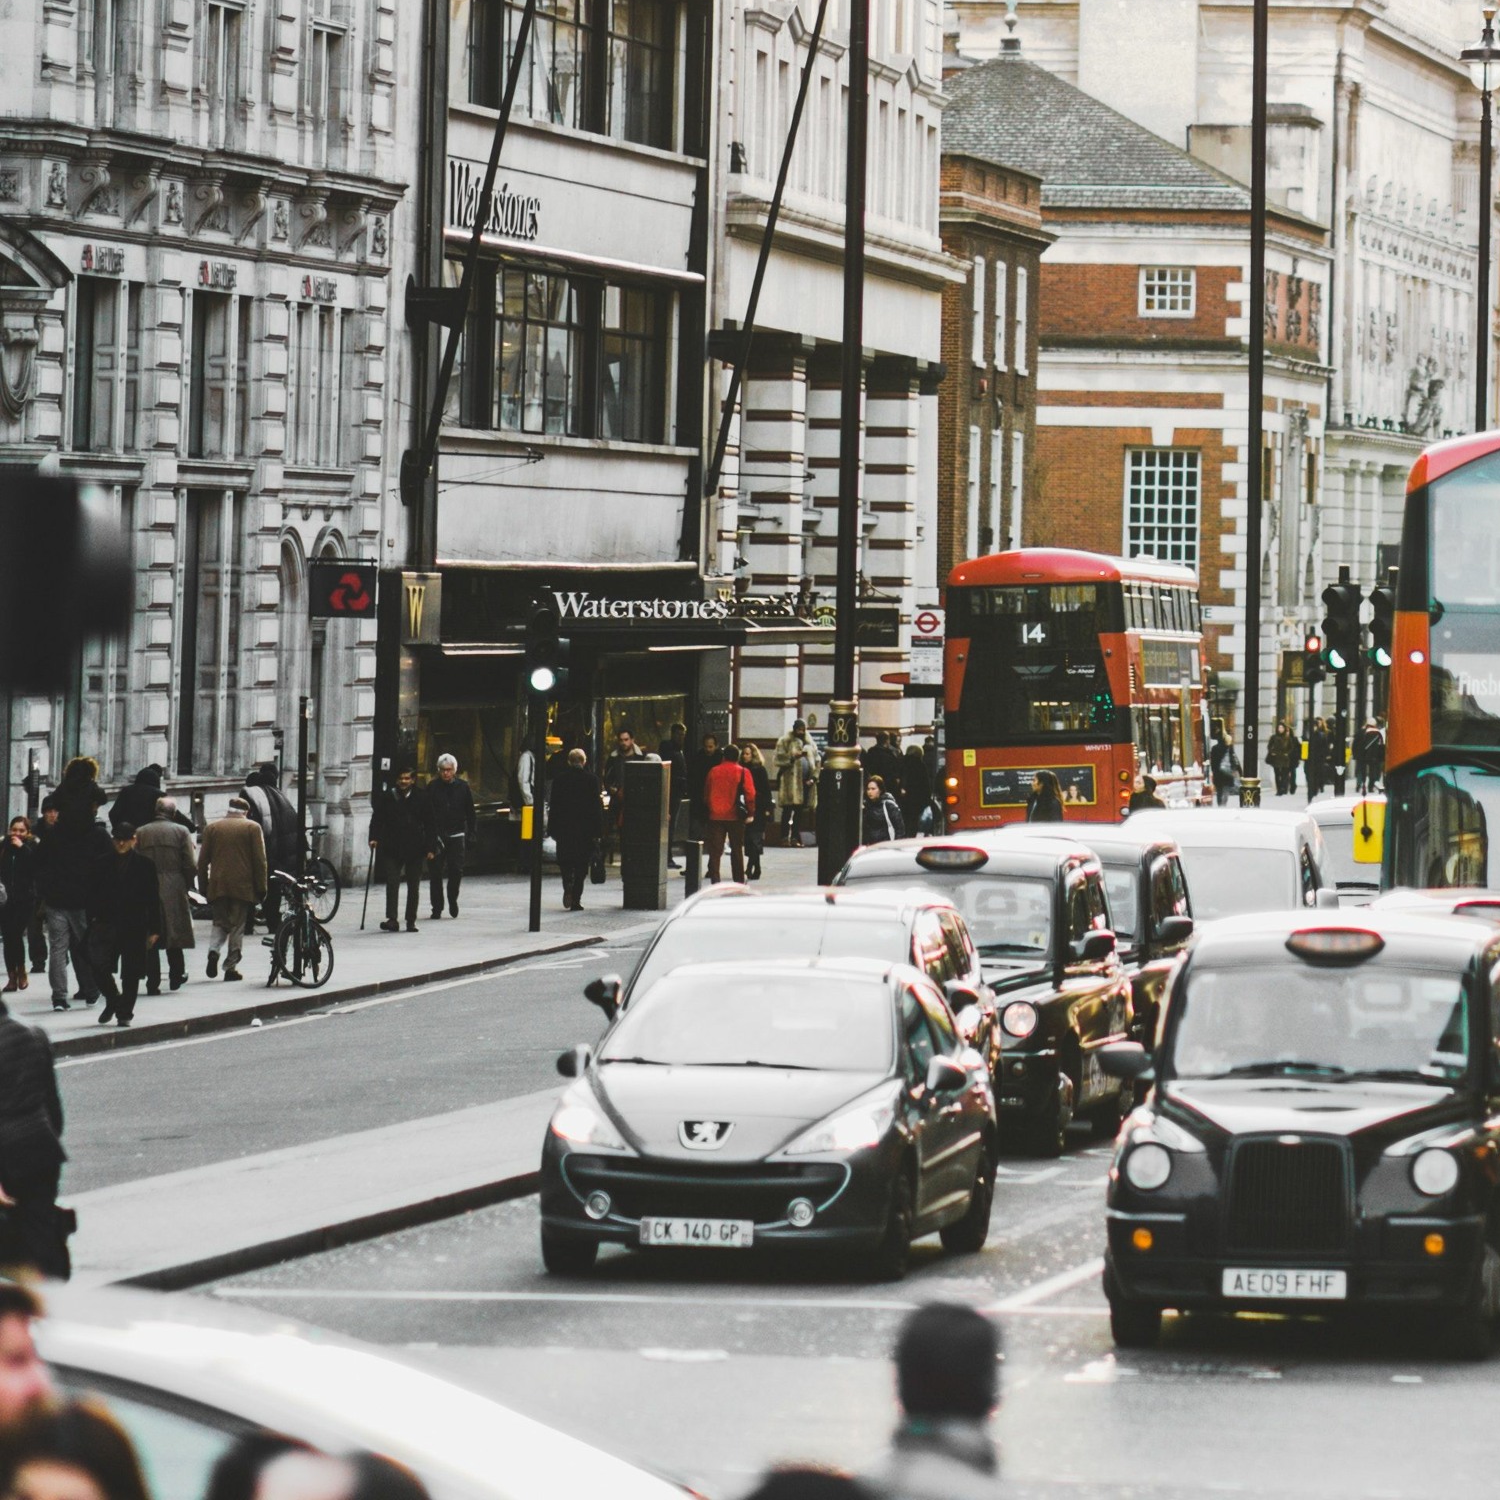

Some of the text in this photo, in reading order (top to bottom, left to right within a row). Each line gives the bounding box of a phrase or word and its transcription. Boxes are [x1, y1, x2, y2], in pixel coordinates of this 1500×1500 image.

[449, 161, 541, 240] Watrstones
[406, 586, 426, 639] W
[552, 591, 728, 619] Waterstones
[1022, 623, 1046, 644] 14
[1233, 1273, 1337, 1294] AE09 FHF
